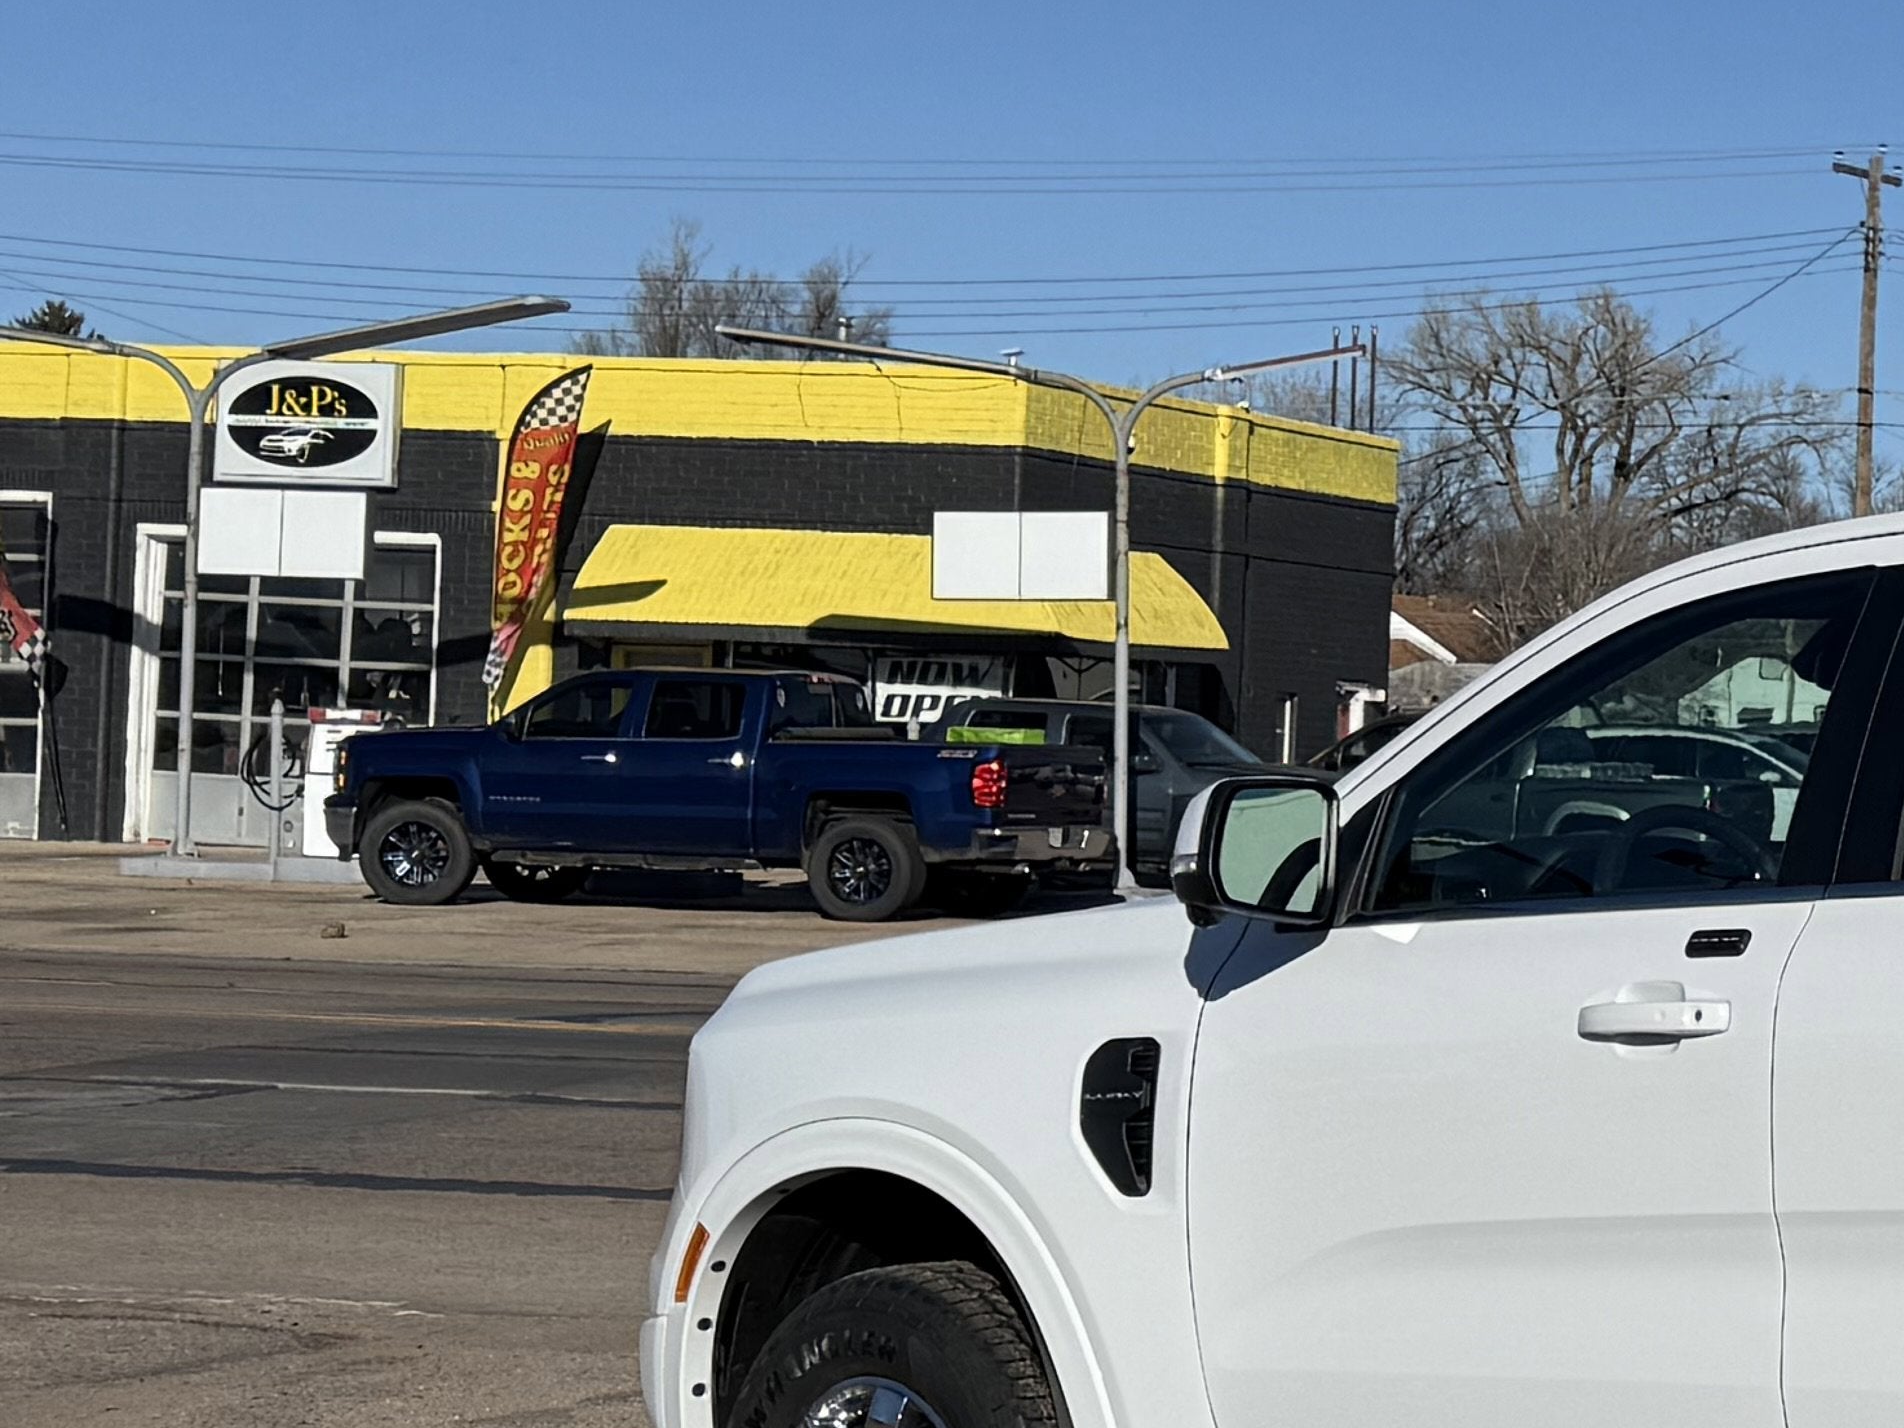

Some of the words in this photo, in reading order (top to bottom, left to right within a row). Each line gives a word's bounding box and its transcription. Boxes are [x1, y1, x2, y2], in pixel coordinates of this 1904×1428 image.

[265, 383, 347, 417] J&P's
[494, 488, 535, 618] OCKS
[887, 660, 994, 688] NOW
[880, 694, 978, 722] OP
